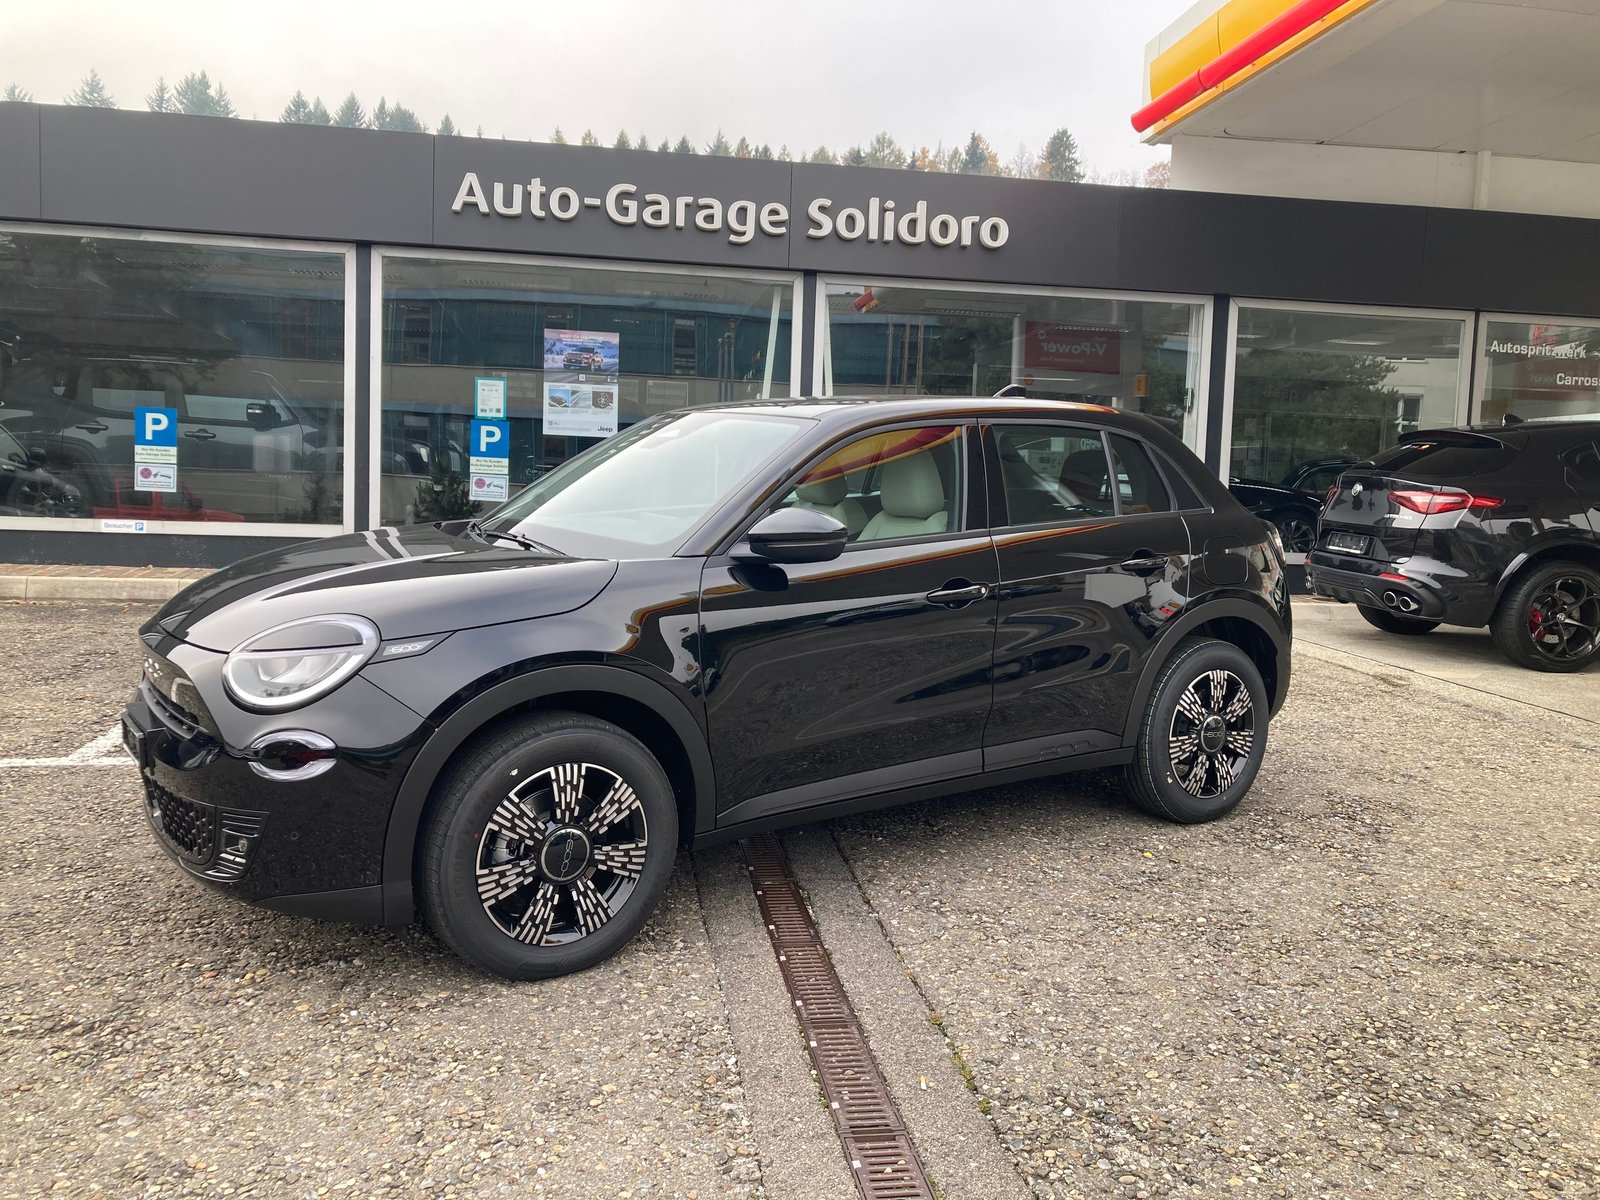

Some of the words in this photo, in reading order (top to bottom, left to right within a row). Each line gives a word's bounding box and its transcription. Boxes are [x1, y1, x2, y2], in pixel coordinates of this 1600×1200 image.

[452, 172, 788, 245] Auto-Garage
[807, 197, 1010, 249] Solidoro
[1490, 340, 1587, 358] Autospritzwerk
[1556, 373, 1600, 387] Carros
[145, 412, 169, 440] P
[597, 425, 613, 433] Jeep
[480, 425, 501, 452] P
